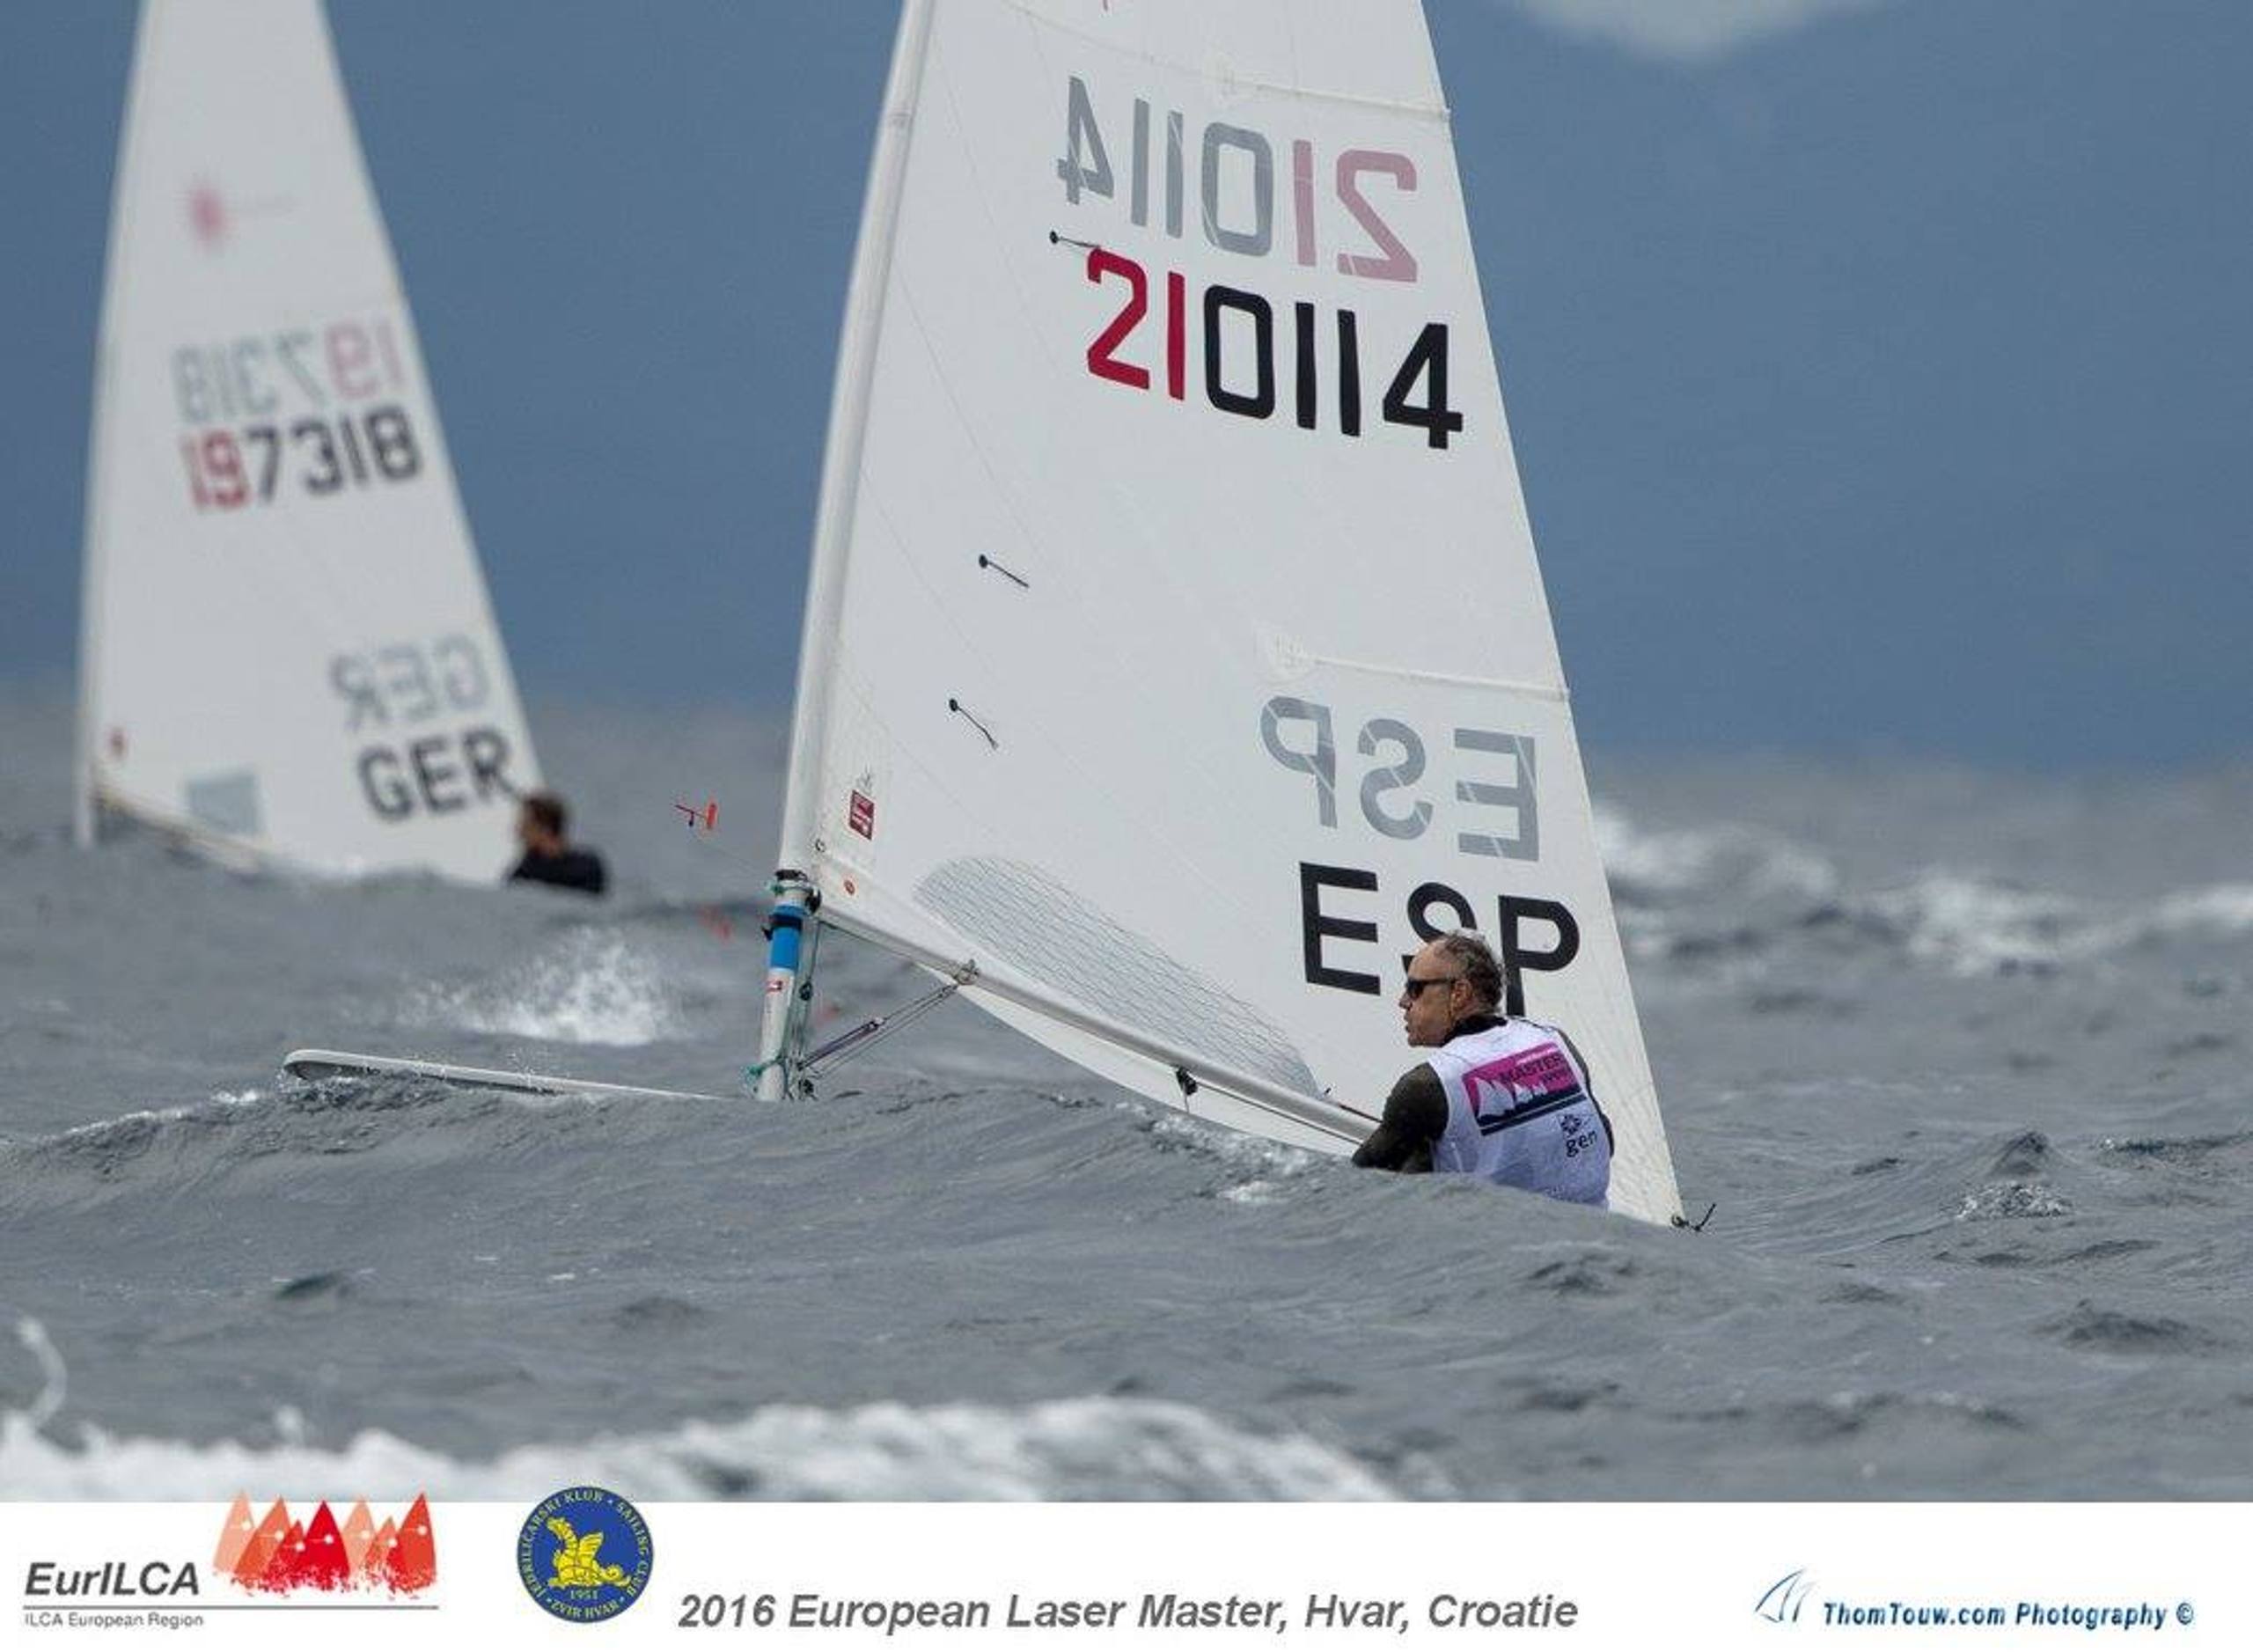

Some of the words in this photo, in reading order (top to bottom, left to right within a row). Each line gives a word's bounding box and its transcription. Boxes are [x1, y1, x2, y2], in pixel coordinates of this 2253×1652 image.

[1087, 247, 1463, 450] 210114
[179, 406, 422, 512] 197318
[357, 728, 521, 821] GER
[1567, 1131, 1598, 1157] gen
